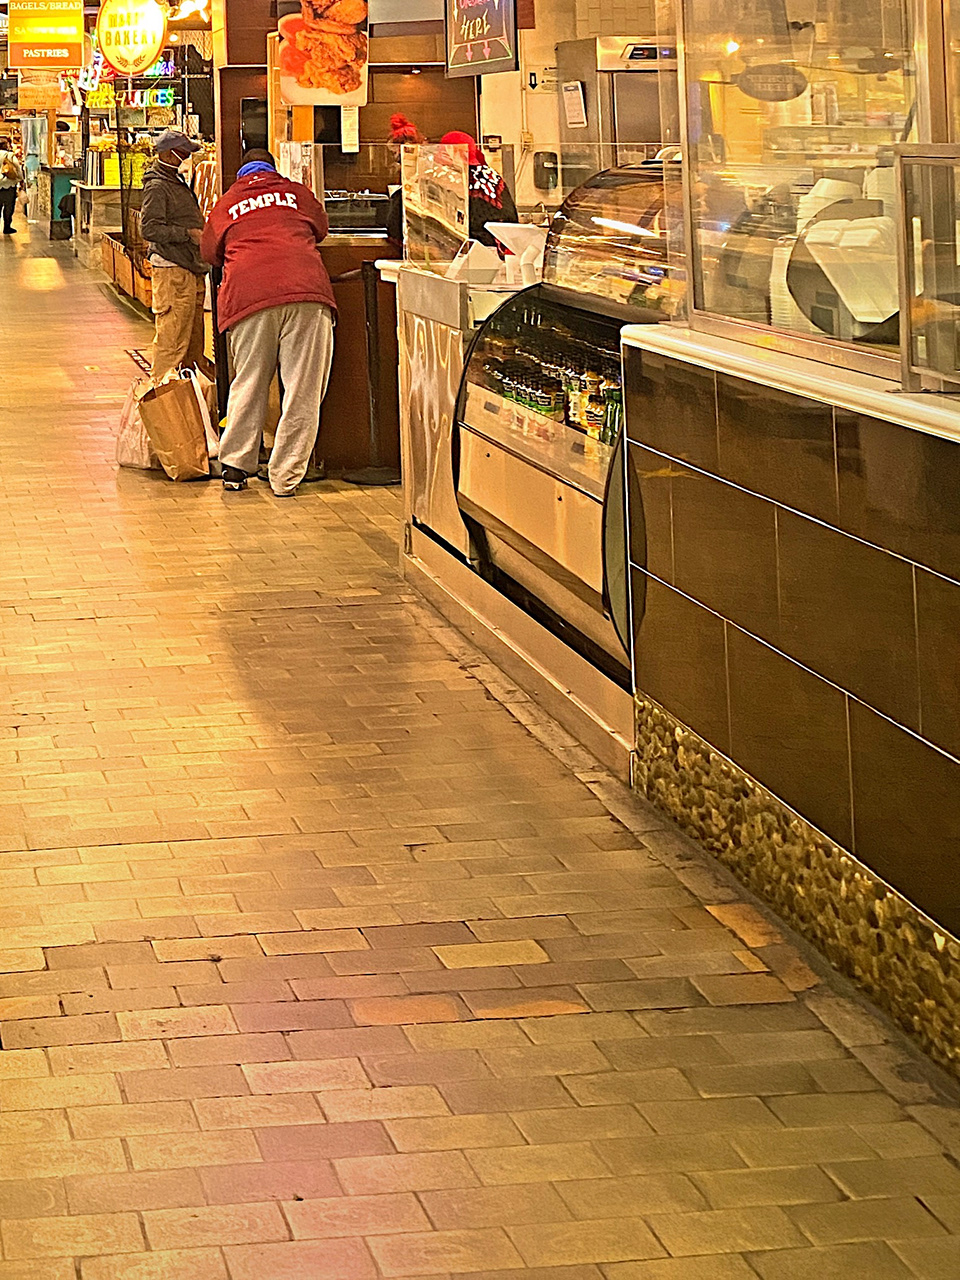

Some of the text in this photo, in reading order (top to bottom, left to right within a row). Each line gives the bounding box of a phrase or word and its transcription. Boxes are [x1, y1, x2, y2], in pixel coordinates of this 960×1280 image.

[10, 2, 81, 11] BAGELS/BREAD
[460, 8, 491, 40] HERE
[22, 49, 70, 58] PASTRIES
[130, 88, 175, 108] JUICES
[228, 192, 298, 221] TEMPLE
